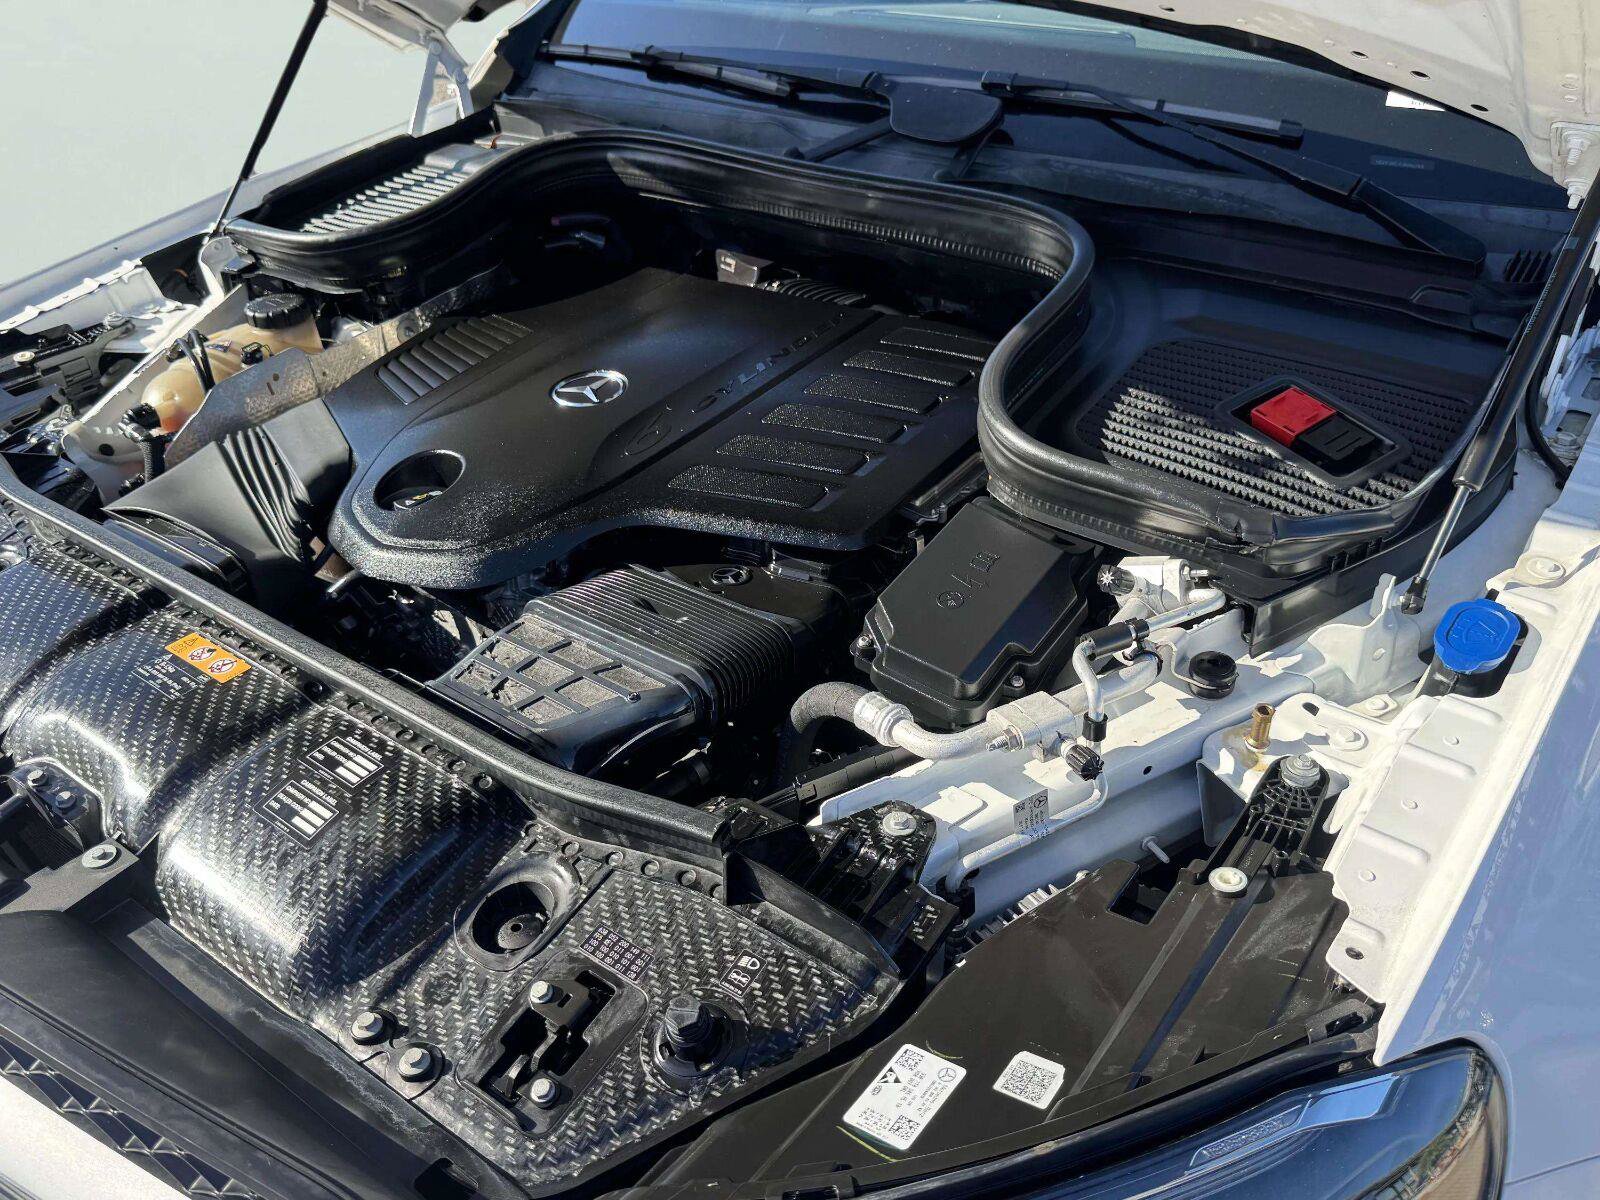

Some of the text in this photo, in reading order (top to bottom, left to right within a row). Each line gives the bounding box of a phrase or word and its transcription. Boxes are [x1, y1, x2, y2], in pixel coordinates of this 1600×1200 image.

[301, 780, 337, 806] CAMPAIGN LABEL
[600, 945, 609, 953] 100
[610, 951, 619, 959] 010
[620, 958, 630, 966] 101
[619, 940, 629, 948] 200
[641, 953, 650, 961] 111
[625, 952, 635, 960] 001
[636, 959, 645, 967] 001
[595, 951, 604, 959] 100
[605, 957, 614, 965] 001
[615, 964, 625, 972] 011
